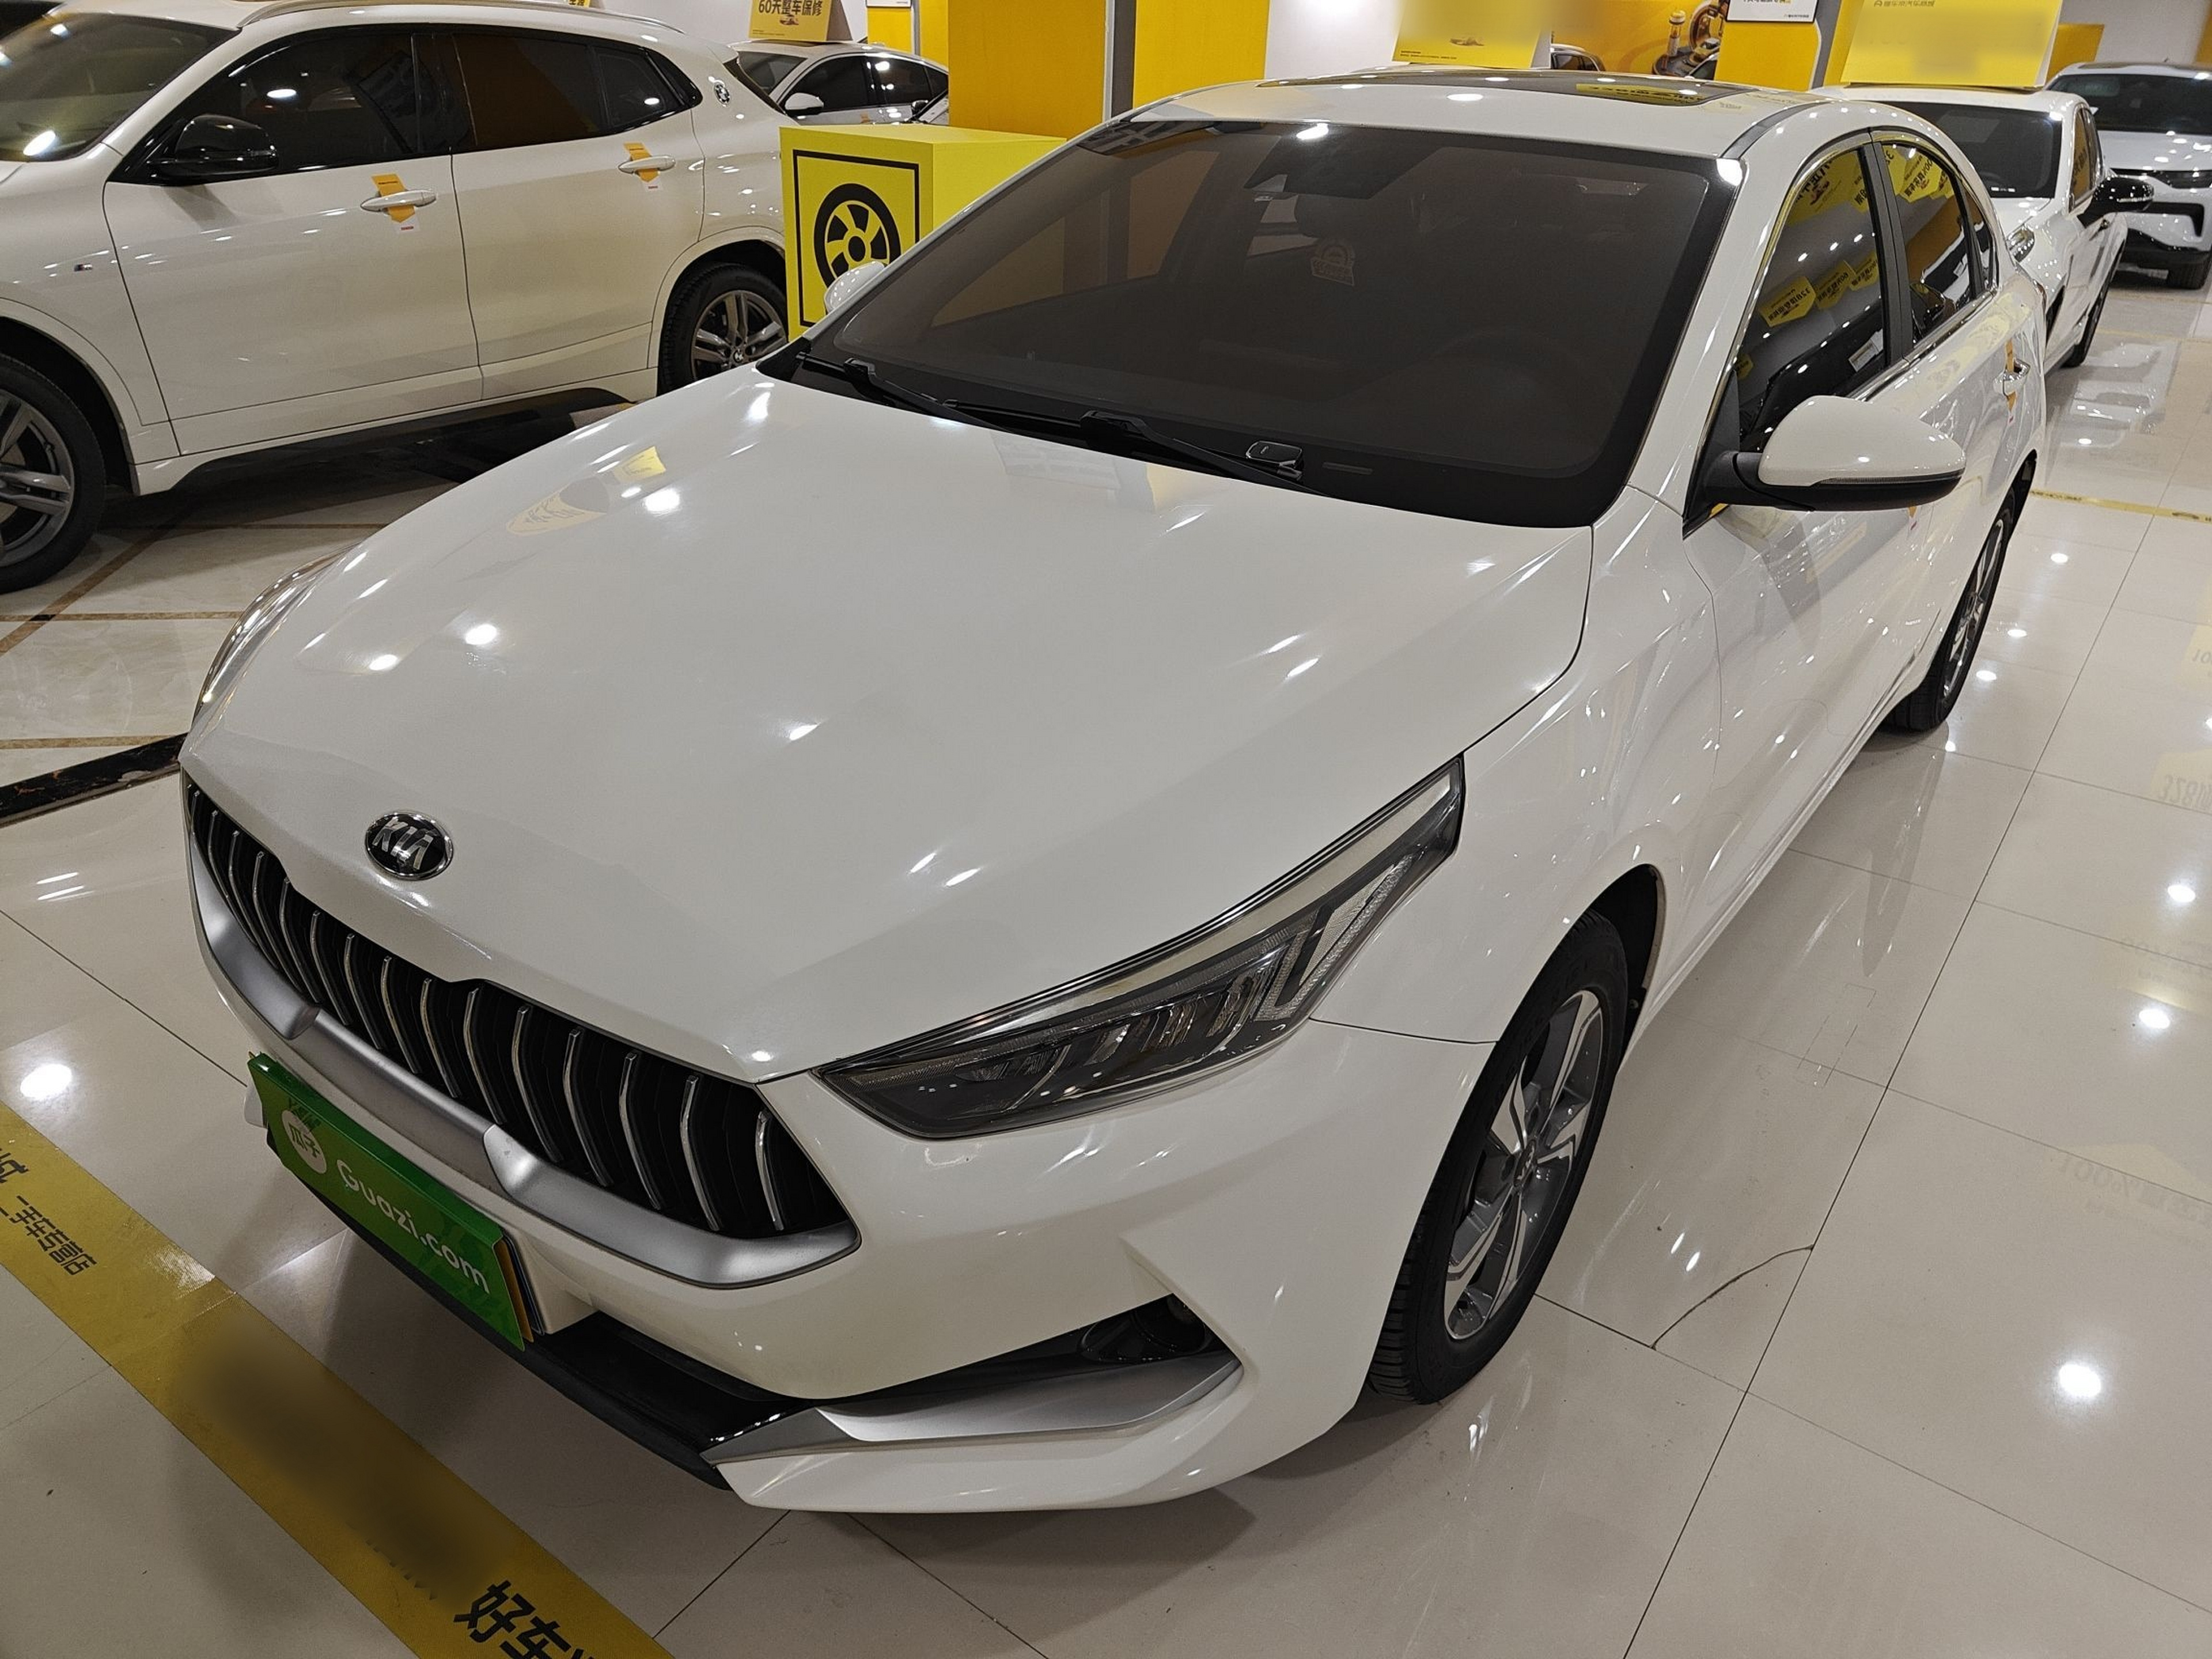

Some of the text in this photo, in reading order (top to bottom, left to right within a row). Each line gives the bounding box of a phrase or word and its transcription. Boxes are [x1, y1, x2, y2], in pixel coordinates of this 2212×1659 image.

[759, 0, 823, 16] 60天整车保修
[372, 816, 434, 870] KIA
[0, 1195, 97, 1275] 二手车专营店
[337, 1160, 490, 1294] Guazi.com
[453, 1580, 597, 1659] 好车
